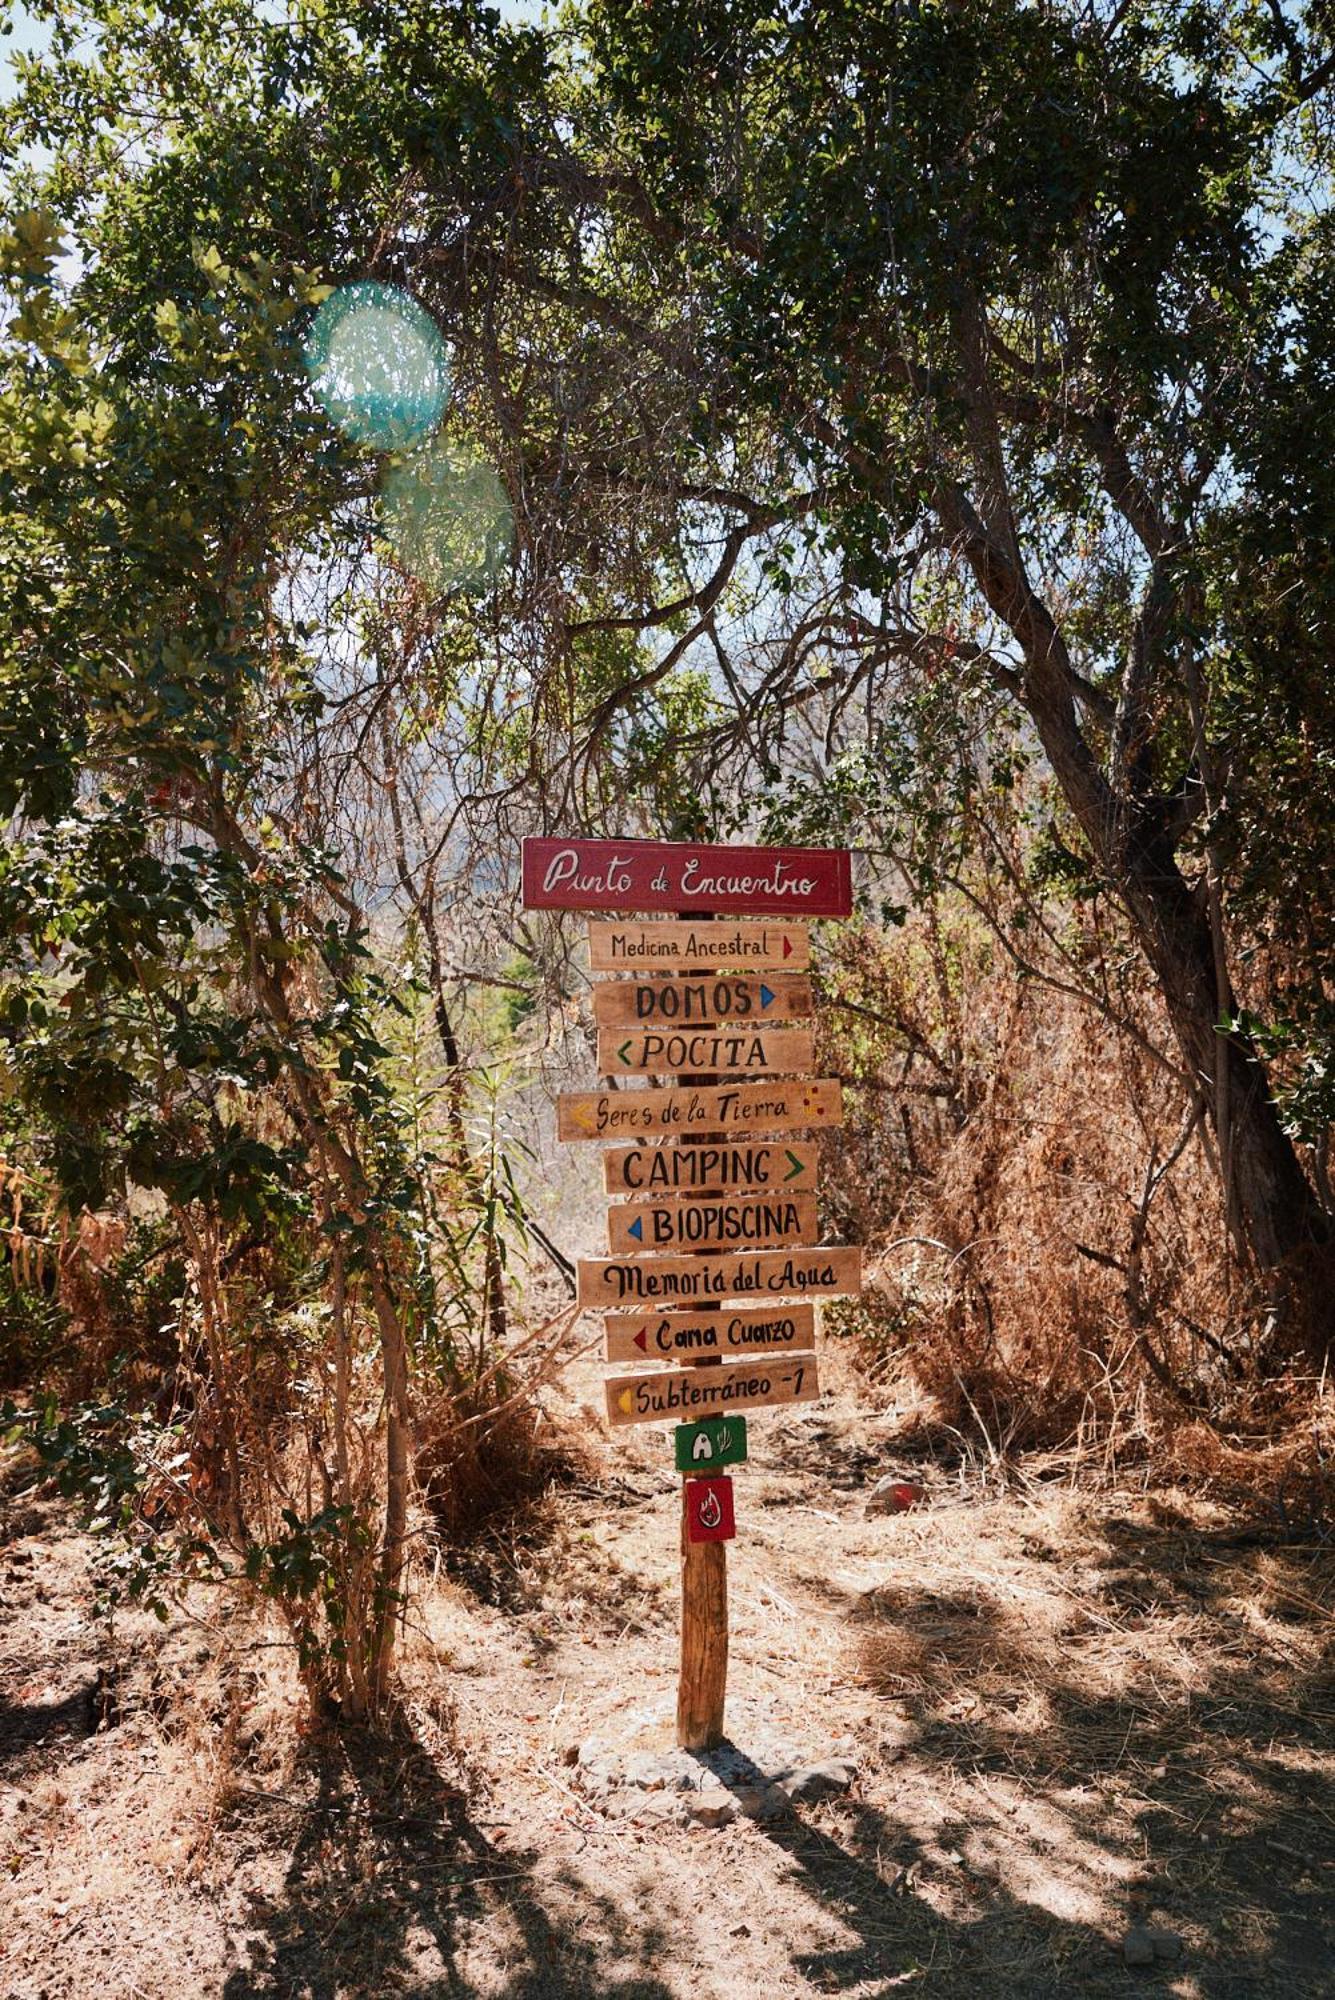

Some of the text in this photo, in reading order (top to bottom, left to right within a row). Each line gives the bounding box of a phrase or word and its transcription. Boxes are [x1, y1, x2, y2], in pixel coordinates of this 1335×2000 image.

[542, 849, 817, 895] Punto de Encuentro
[611, 930, 770, 957] Medicina Ancestral
[636, 981, 752, 1018] DOMOS
[640, 1035, 768, 1068] POCITA
[597, 1092, 789, 1130] Seres de la Tierra
[623, 1149, 770, 1188] CAMPING
[652, 1203, 801, 1243] BIOPISCINA
[604, 1260, 838, 1298] Memoria del Agua
[727, 1318, 795, 1346] Cuarzo
[636, 1367, 804, 1414] Subterráneo -1
